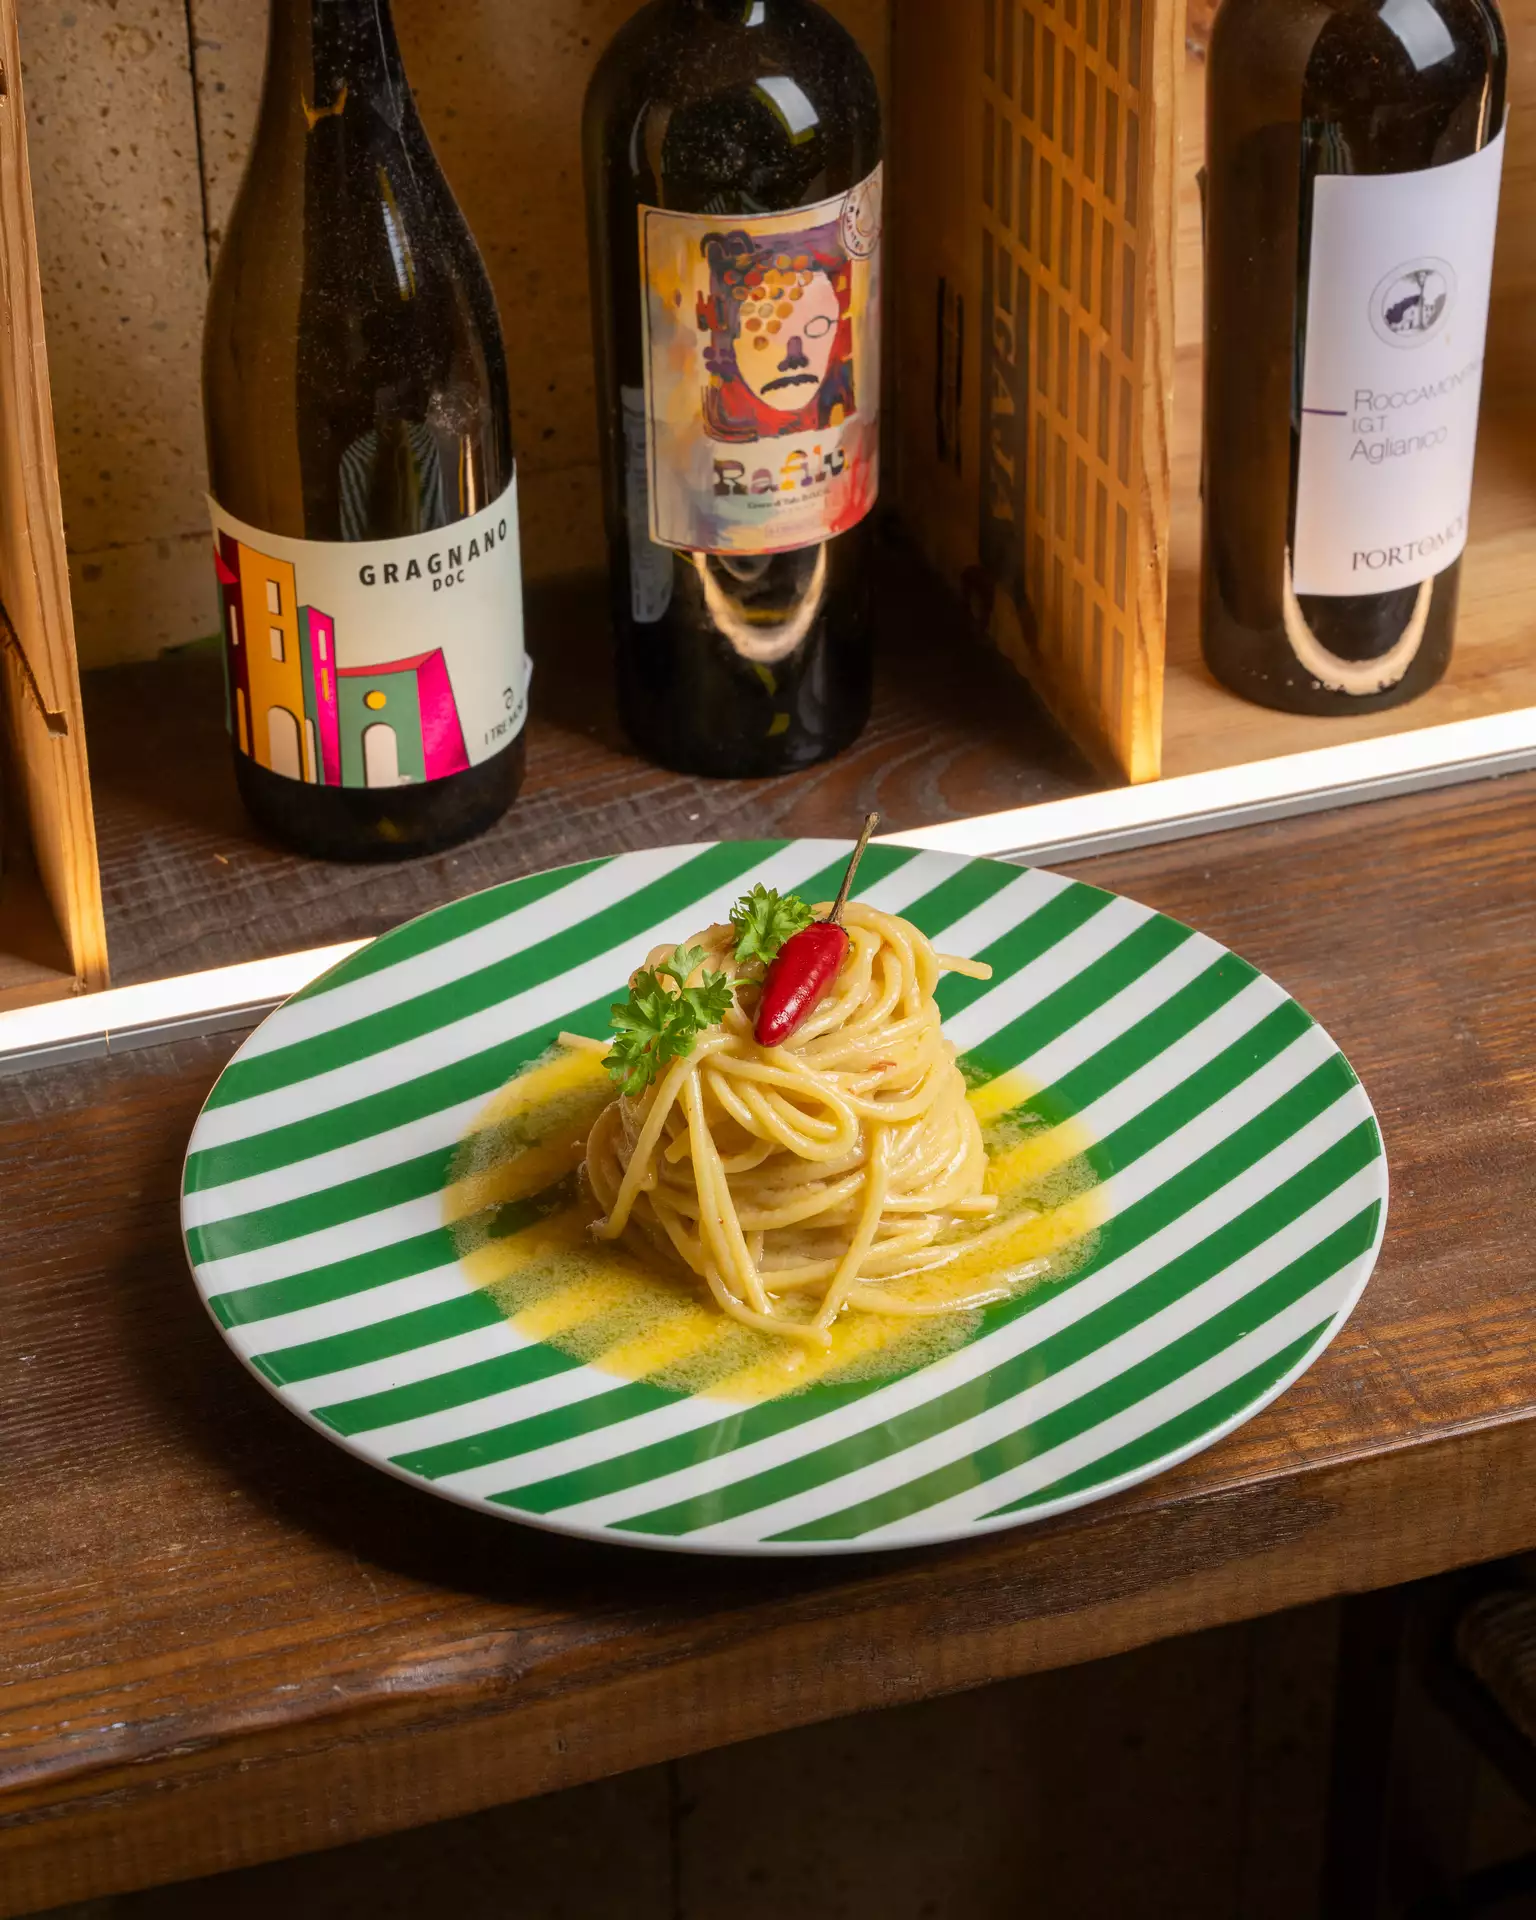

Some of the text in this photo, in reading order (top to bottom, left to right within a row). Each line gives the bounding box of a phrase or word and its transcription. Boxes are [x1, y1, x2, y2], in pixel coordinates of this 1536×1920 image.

[1350, 425, 1448, 465] Aglianico
[359, 518, 506, 586] GRAGNANO
[432, 569, 465, 592] DOC
